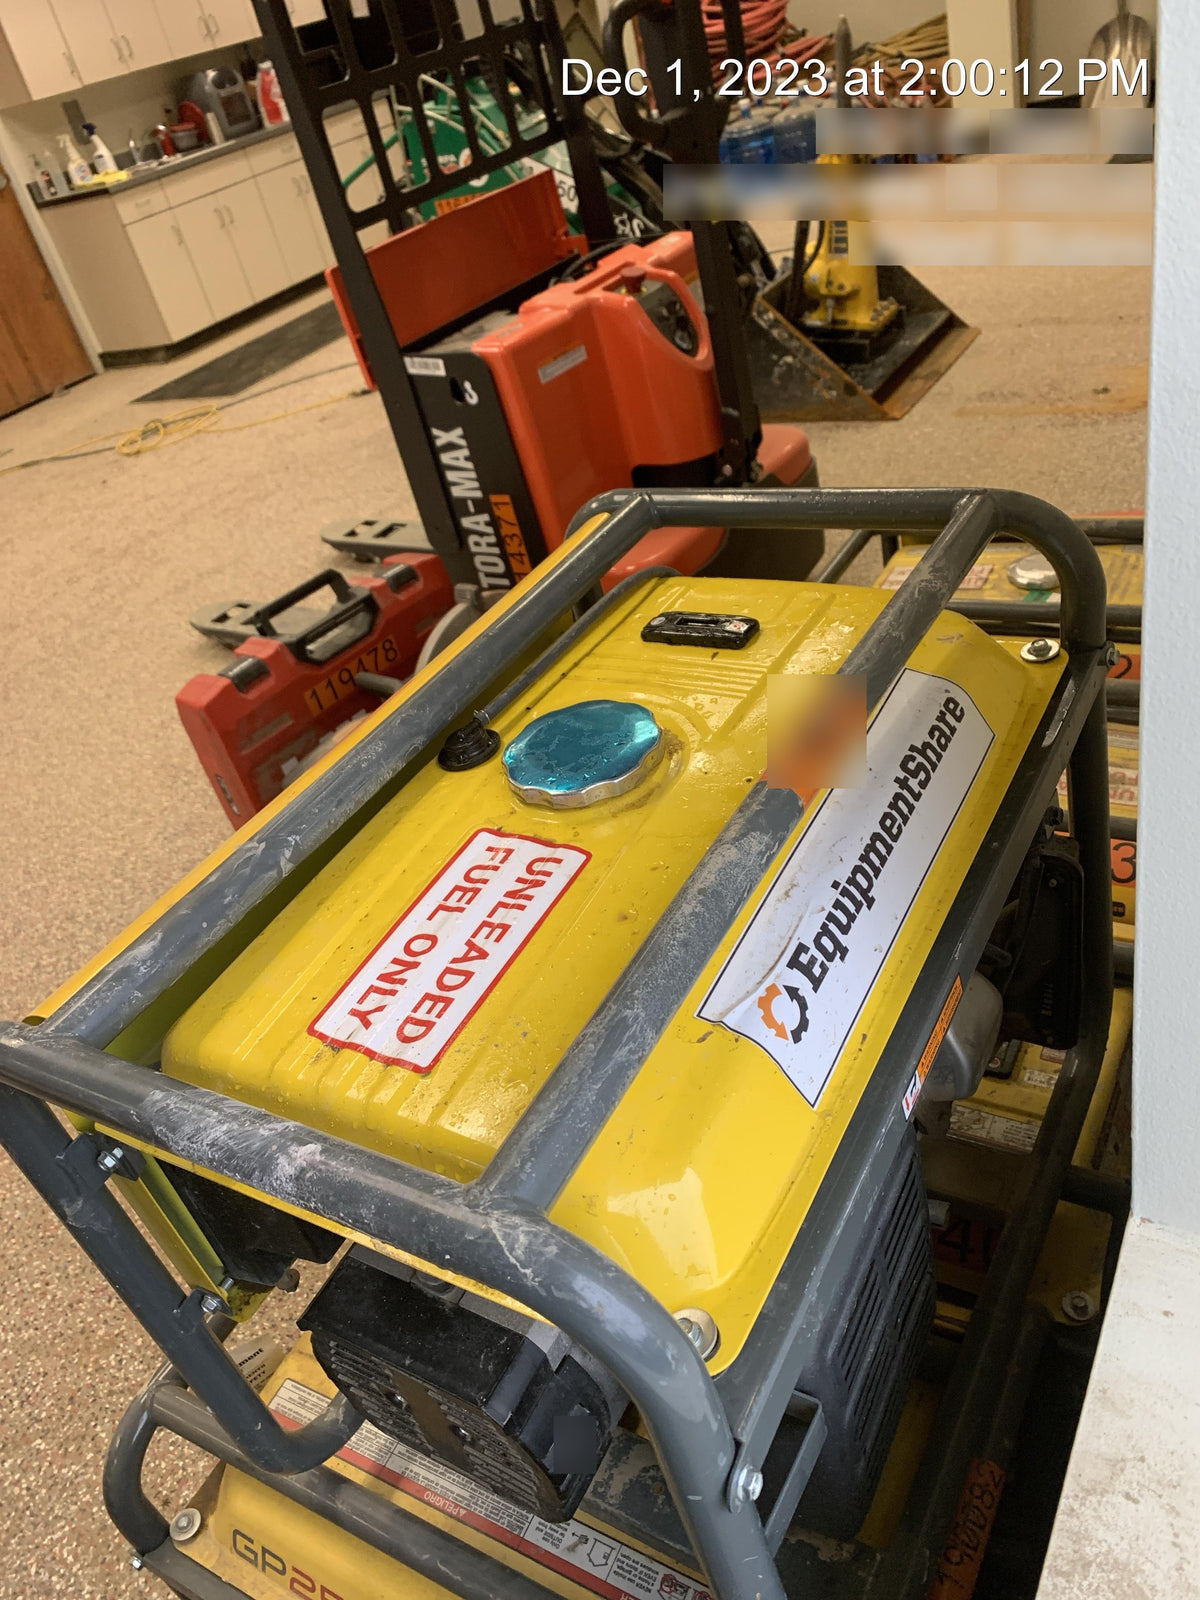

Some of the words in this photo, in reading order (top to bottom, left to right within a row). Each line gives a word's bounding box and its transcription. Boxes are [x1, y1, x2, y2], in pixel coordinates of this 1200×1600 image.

[431, 426, 510, 589] TORA-MAX
[426, 845, 515, 922] FUEL
[786, 694, 966, 993] EquipmentShare
[347, 933, 438, 1031] ONLY
[396, 856, 564, 1044] UNLEADED
[423, 1489, 460, 1516] PELIGRO
